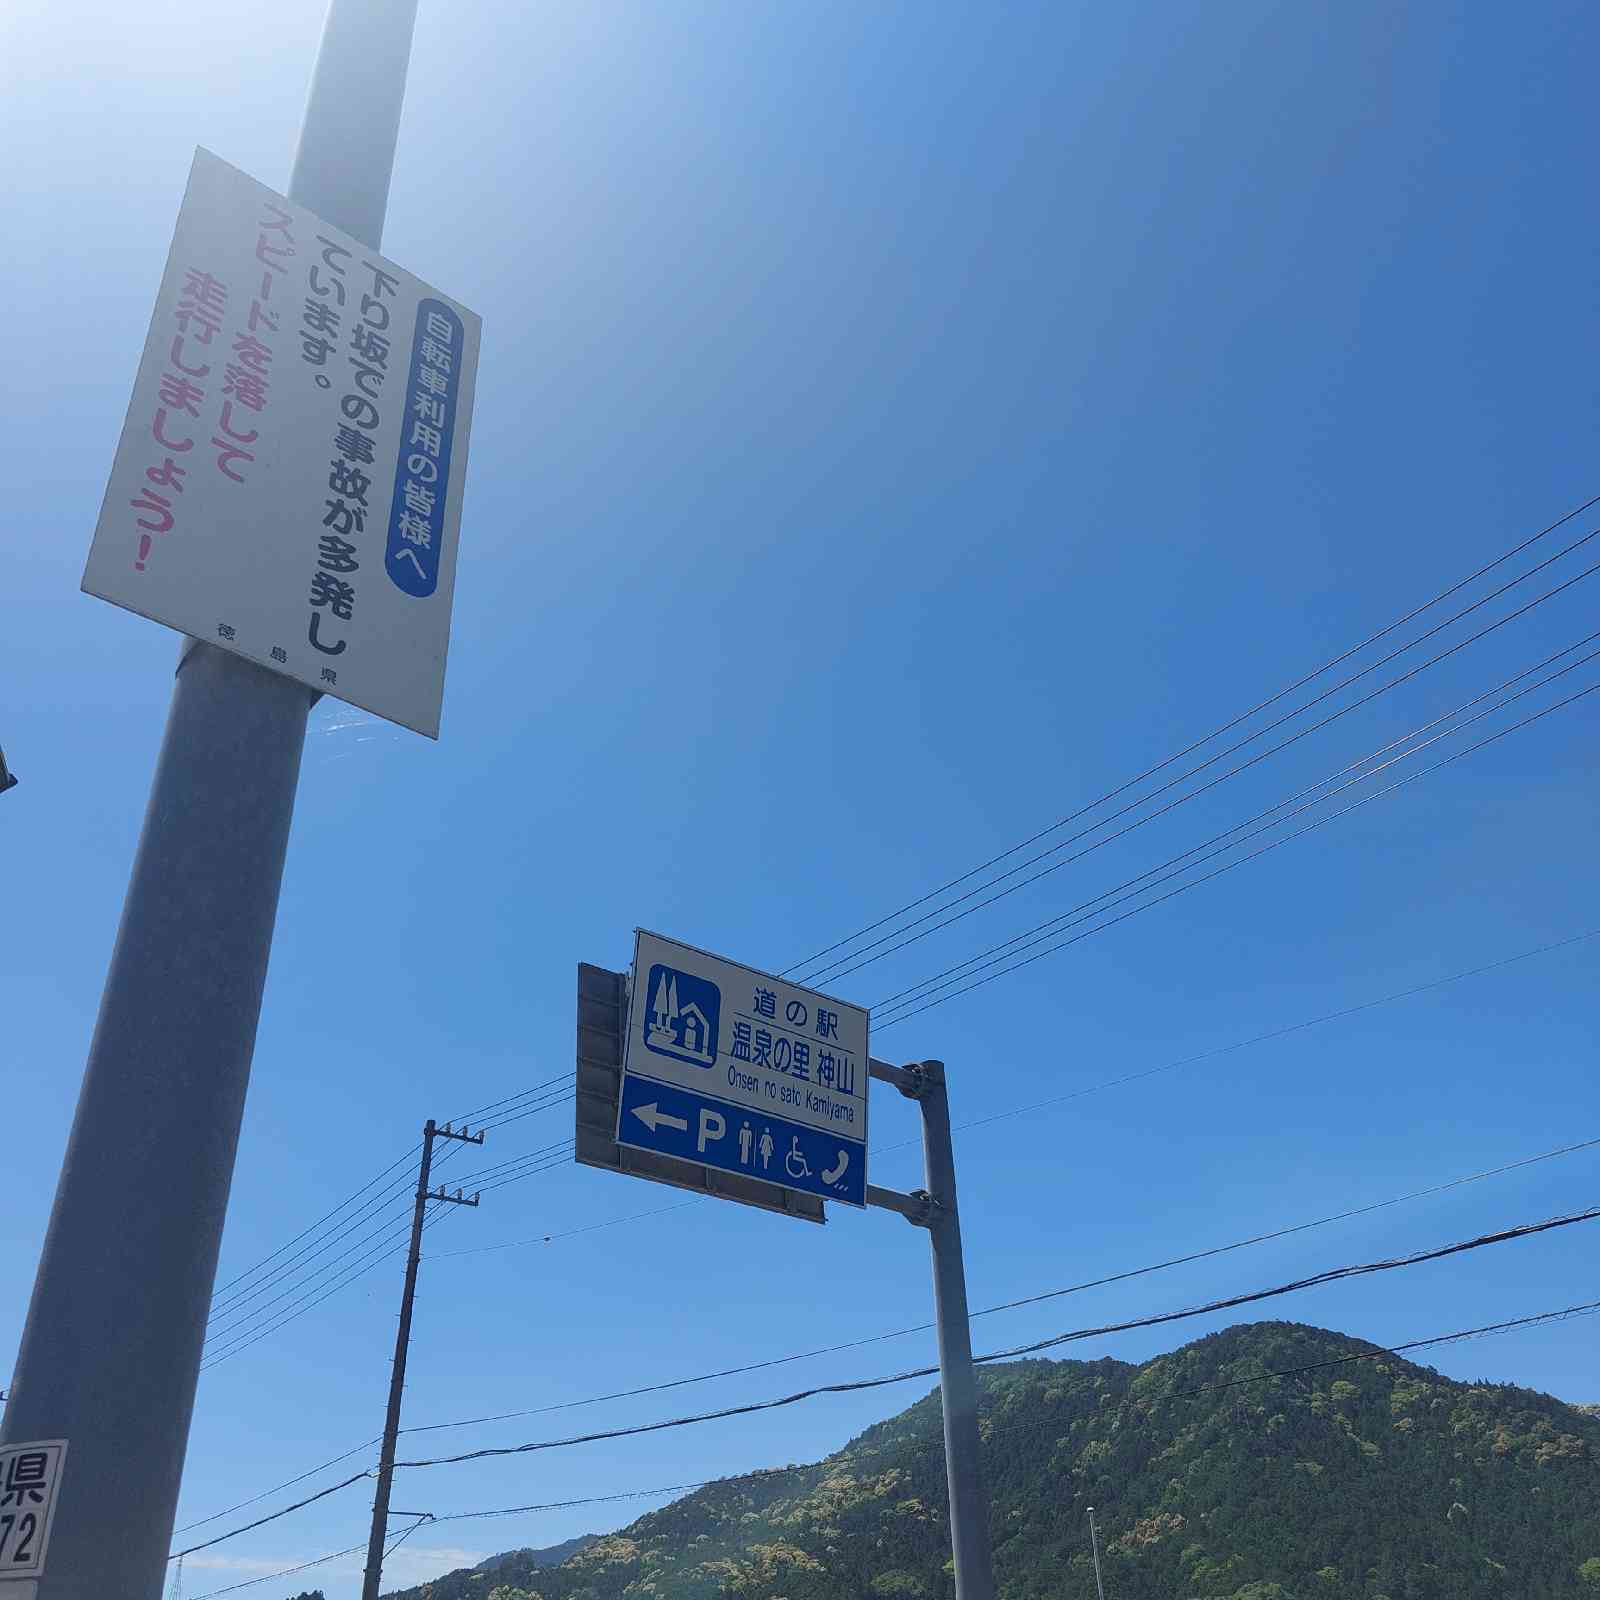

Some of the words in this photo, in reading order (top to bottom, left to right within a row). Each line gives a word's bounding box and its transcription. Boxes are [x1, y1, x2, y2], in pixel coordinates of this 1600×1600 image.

[216, 202, 297, 484] スピードを落して
[298, 234, 353, 390] ています。
[308, 258, 400, 656] 下り坂での事故が多発し
[394, 310, 453, 581] 自転車利用の皆様へ
[753, 987, 839, 1041] 道の駅
[696, 1108, 727, 1153] P
[727, 1065, 759, 1093] Onsen
[764, 1079, 777, 1099] no
[780, 1082, 801, 1106] sato
[805, 1088, 855, 1122] Kamiyama
[0, 1452, 48, 1507] 県
